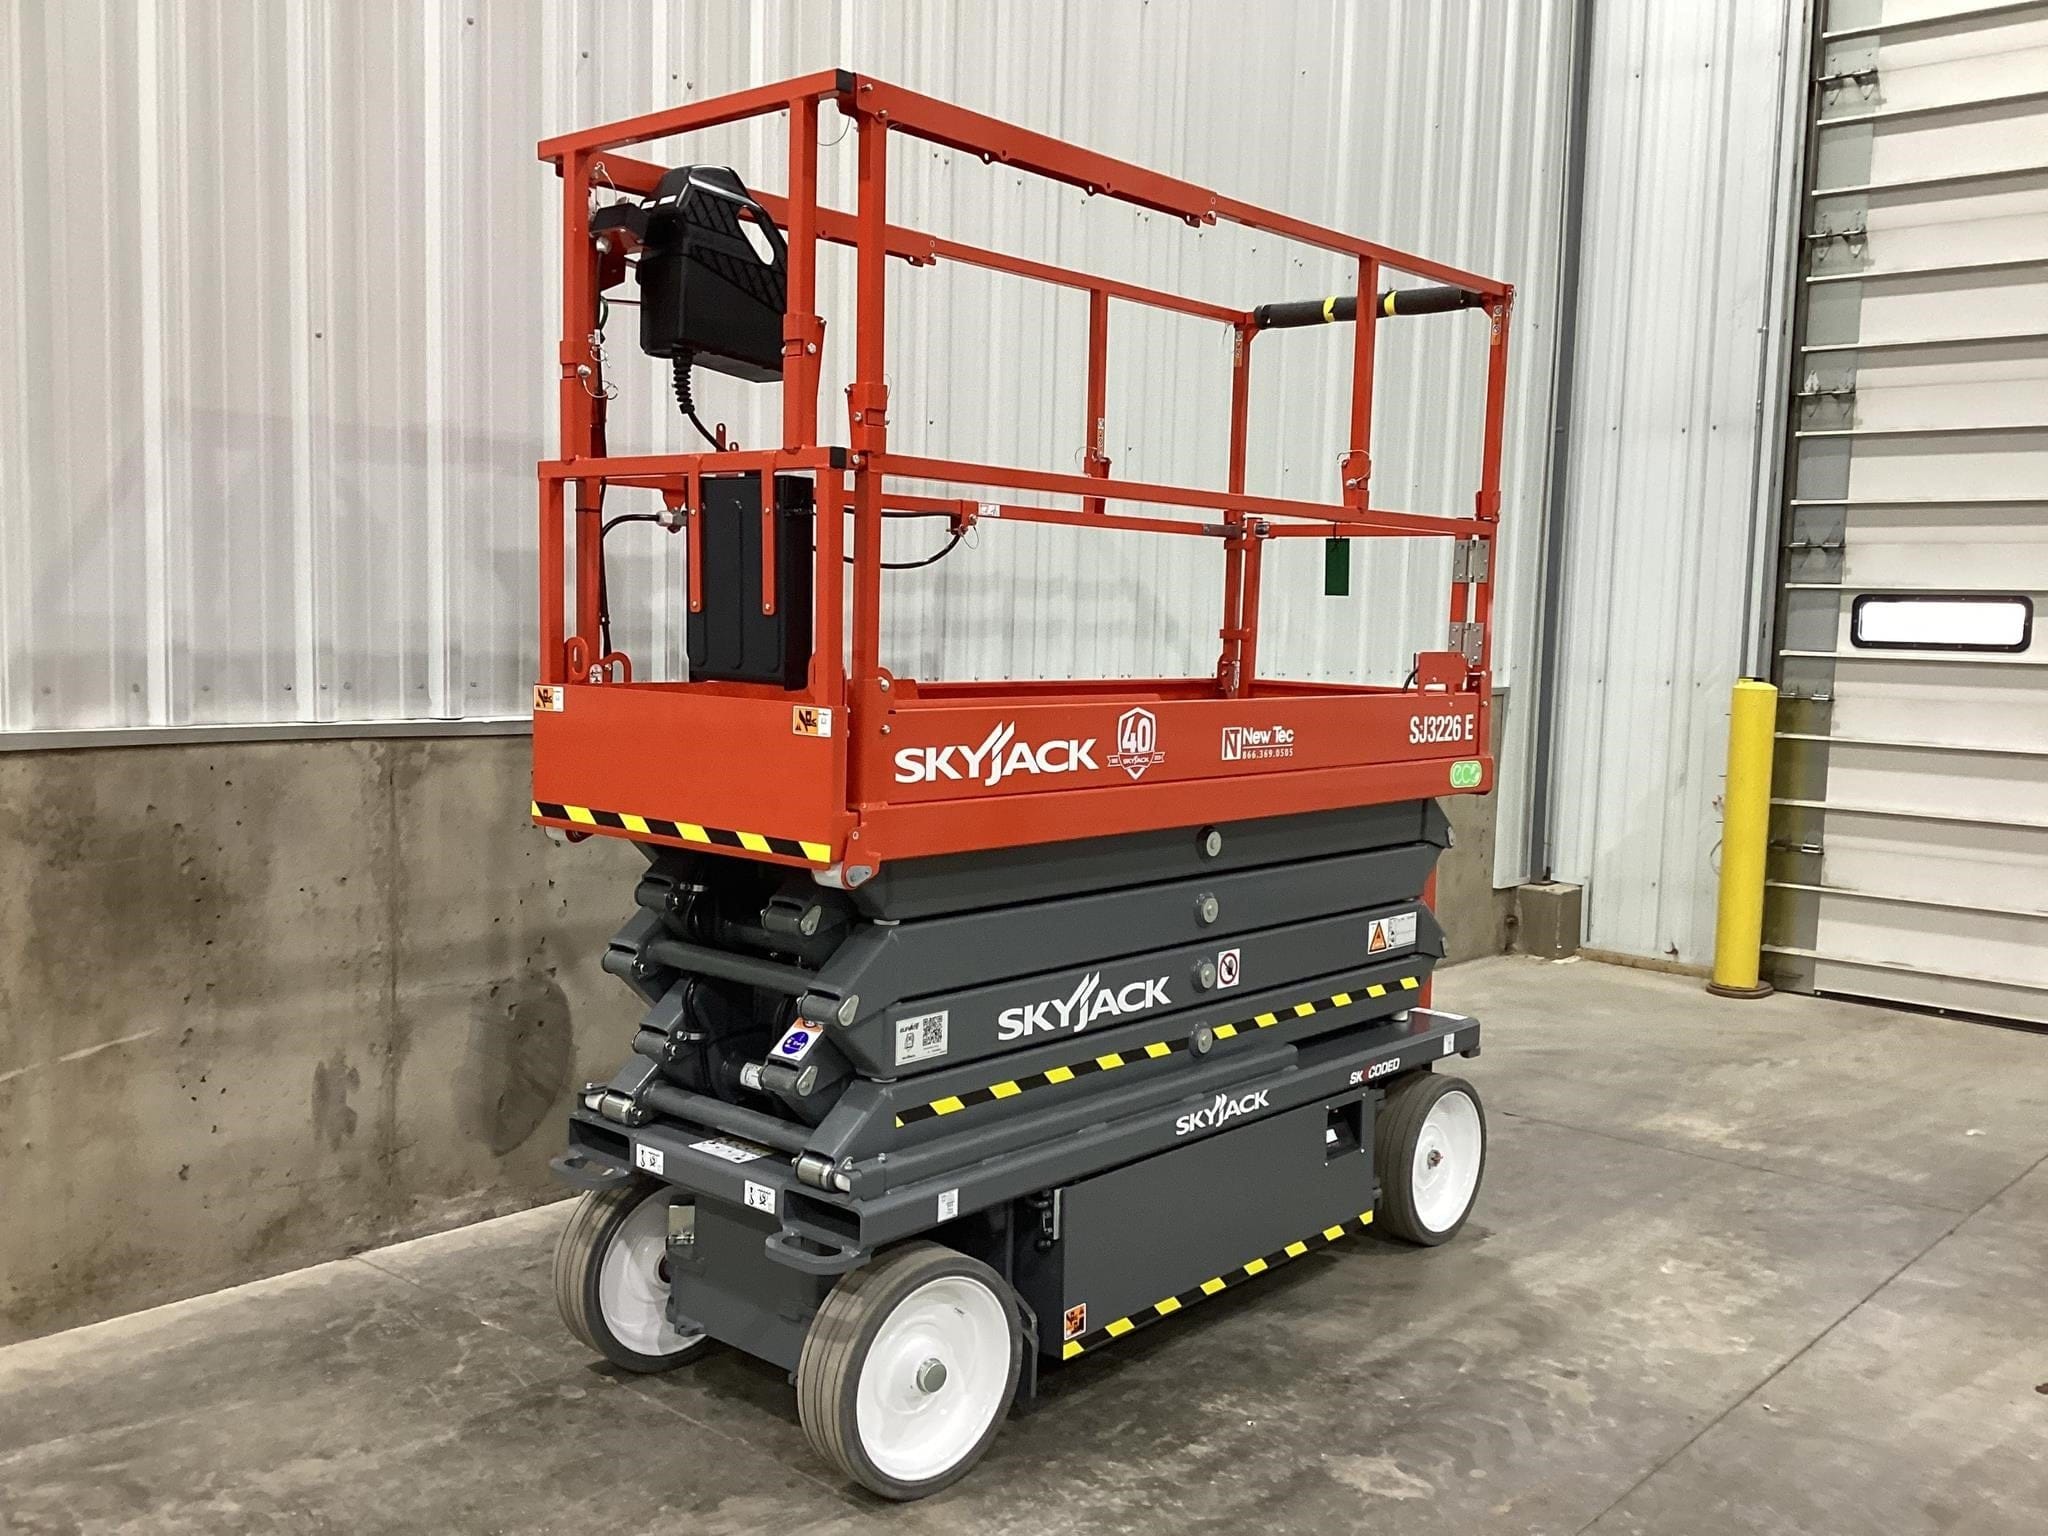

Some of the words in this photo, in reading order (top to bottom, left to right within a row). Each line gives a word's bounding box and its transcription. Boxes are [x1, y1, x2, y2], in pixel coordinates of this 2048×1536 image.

[1122, 716, 1151, 752] 40
[1242, 727, 1272, 745] New
[1272, 726, 1294, 743] Tec
[1409, 715, 1462, 743] SJ3226
[1465, 714, 1474, 740] E
[895, 721, 1099, 787] SKYJACK
[998, 971, 1172, 1041] SKYJACK
[1175, 1089, 1270, 1136] SKYJACK
